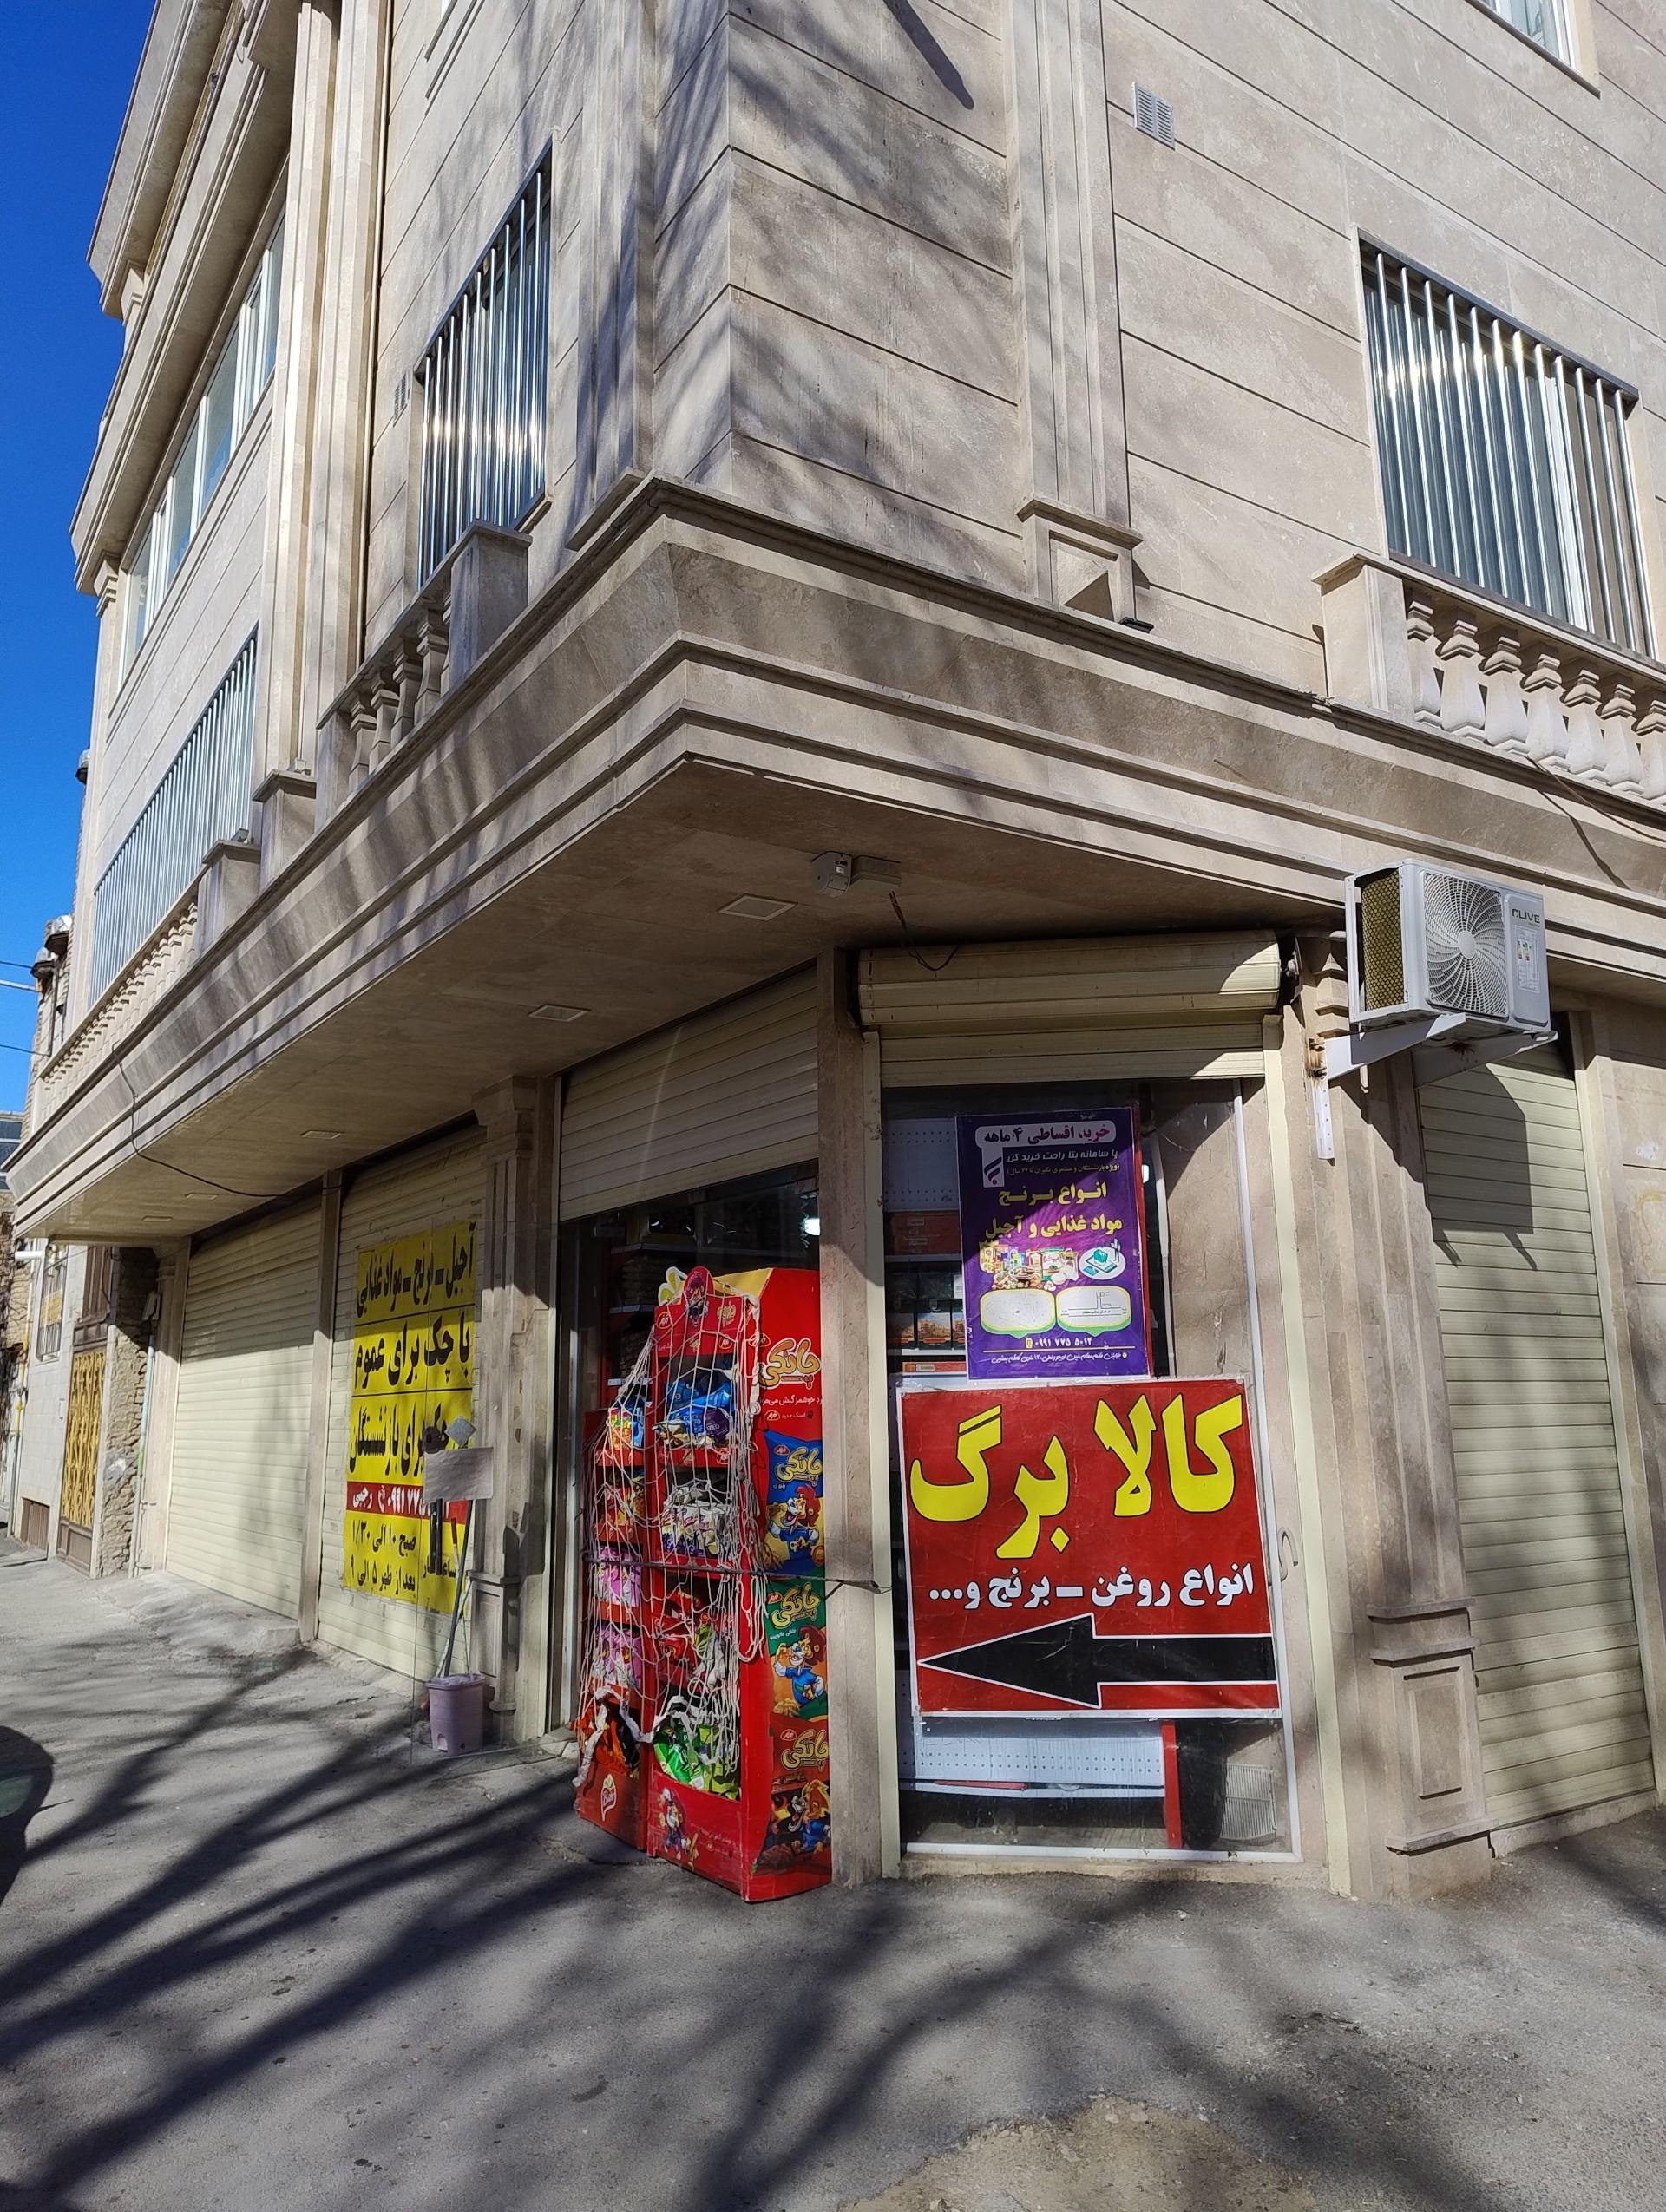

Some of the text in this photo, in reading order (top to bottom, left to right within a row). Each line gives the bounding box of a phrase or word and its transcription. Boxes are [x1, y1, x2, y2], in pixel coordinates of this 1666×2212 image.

[984, 1129, 1011, 1143] ماهه
[1027, 1125, 1075, 1145] اقساطی
[1021, 1152, 1040, 1163] خرید
[1042, 1151, 1066, 1161] راحت
[1080, 1149, 1108, 1159] سامانه
[999, 1181, 1107, 1207] انواع برنج
[985, 1213, 1123, 1239] مواد غذایی و آجیل
[357, 1221, 476, 1318] آجیل برنج مواد غذایی
[355, 1311, 470, 1390] با چک برای عموم
[1035, 1338, 1052, 1347] ۰۹۹۱
[349, 1403, 400, 1476] بازنشستگان
[909, 1393, 1243, 1560] کالا برگ
[352, 1486, 373, 1509] رجبی
[372, 1523, 387, 1553] الی
[398, 1534, 416, 1558] صبح
[357, 1558, 370, 1587] الی
[371, 1560, 377, 1585] ۵
[379, 1562, 392, 1592] ظهر
[395, 1565, 402, 1595] از
[403, 1572, 416, 1599] بعد
[1091, 1565, 1171, 1607] روغن
[1178, 1562, 1255, 1607] انواع
[987, 1567, 1052, 1609] برنج
